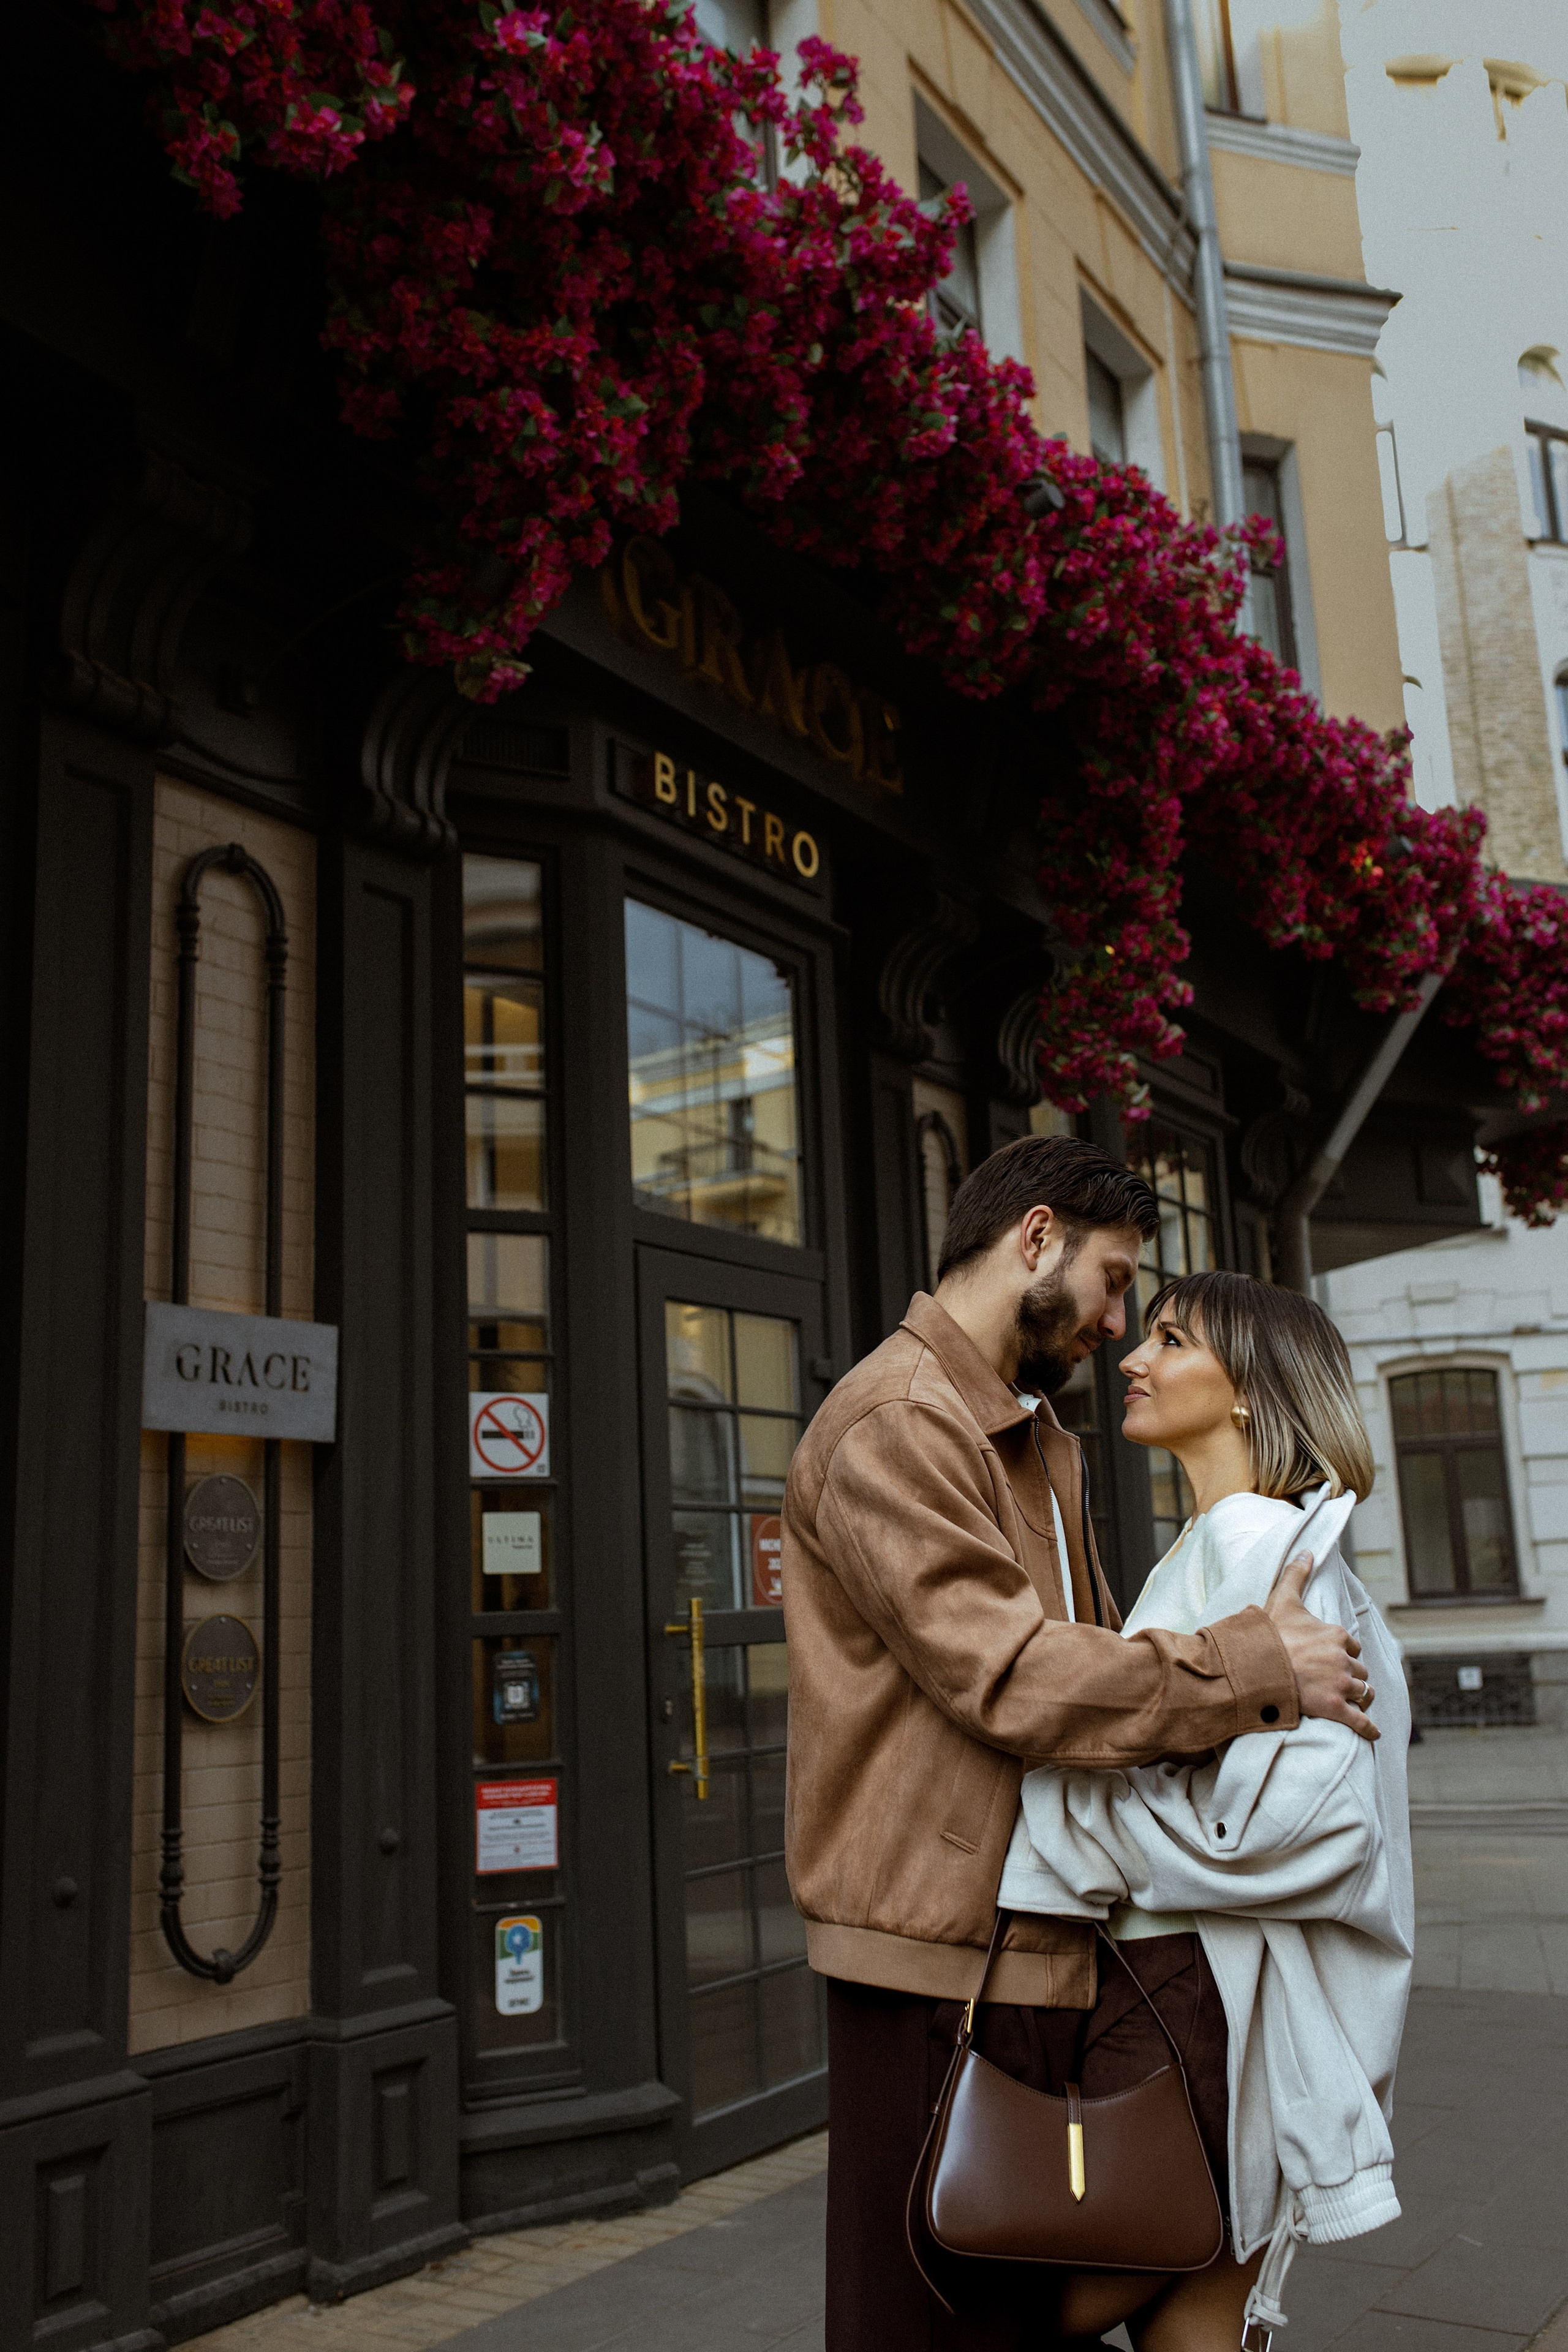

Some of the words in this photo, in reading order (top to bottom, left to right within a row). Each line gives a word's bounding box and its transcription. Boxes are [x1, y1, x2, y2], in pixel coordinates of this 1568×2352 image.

[600, 535, 904, 796] GRACE
[654, 752, 820, 878] BISTRO
[175, 1343, 311, 1392] GRACE
[219, 1400, 268, 1415] BISTRO
